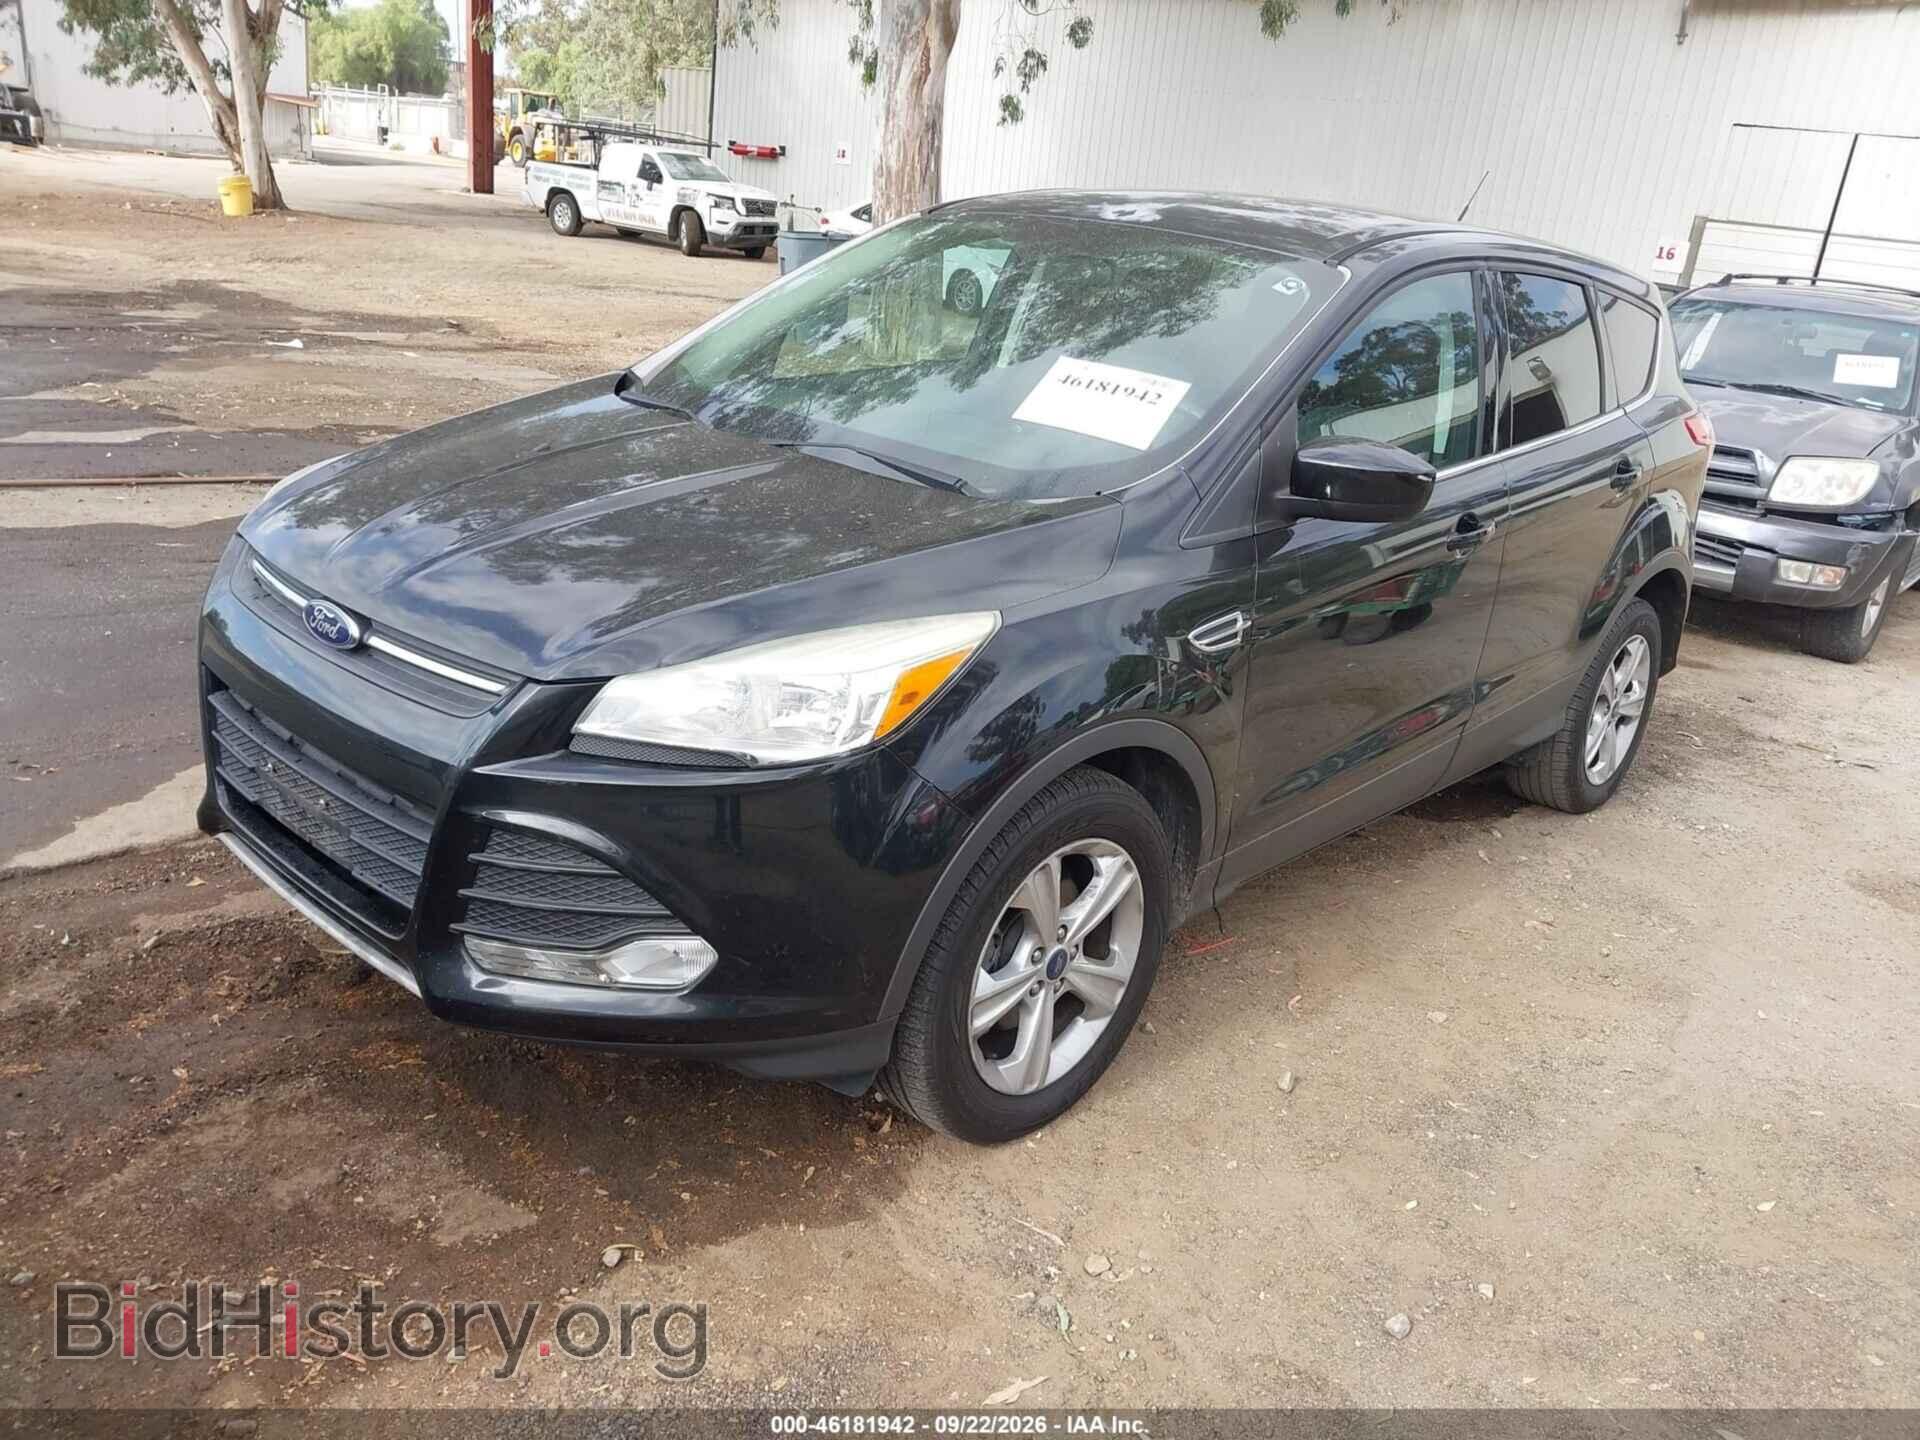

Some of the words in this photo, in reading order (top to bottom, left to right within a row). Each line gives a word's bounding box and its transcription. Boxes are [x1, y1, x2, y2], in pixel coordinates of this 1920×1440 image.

[1655, 246, 1676, 260] 16
[1057, 373, 1163, 405] 46181942
[309, 606, 341, 640] Ford
